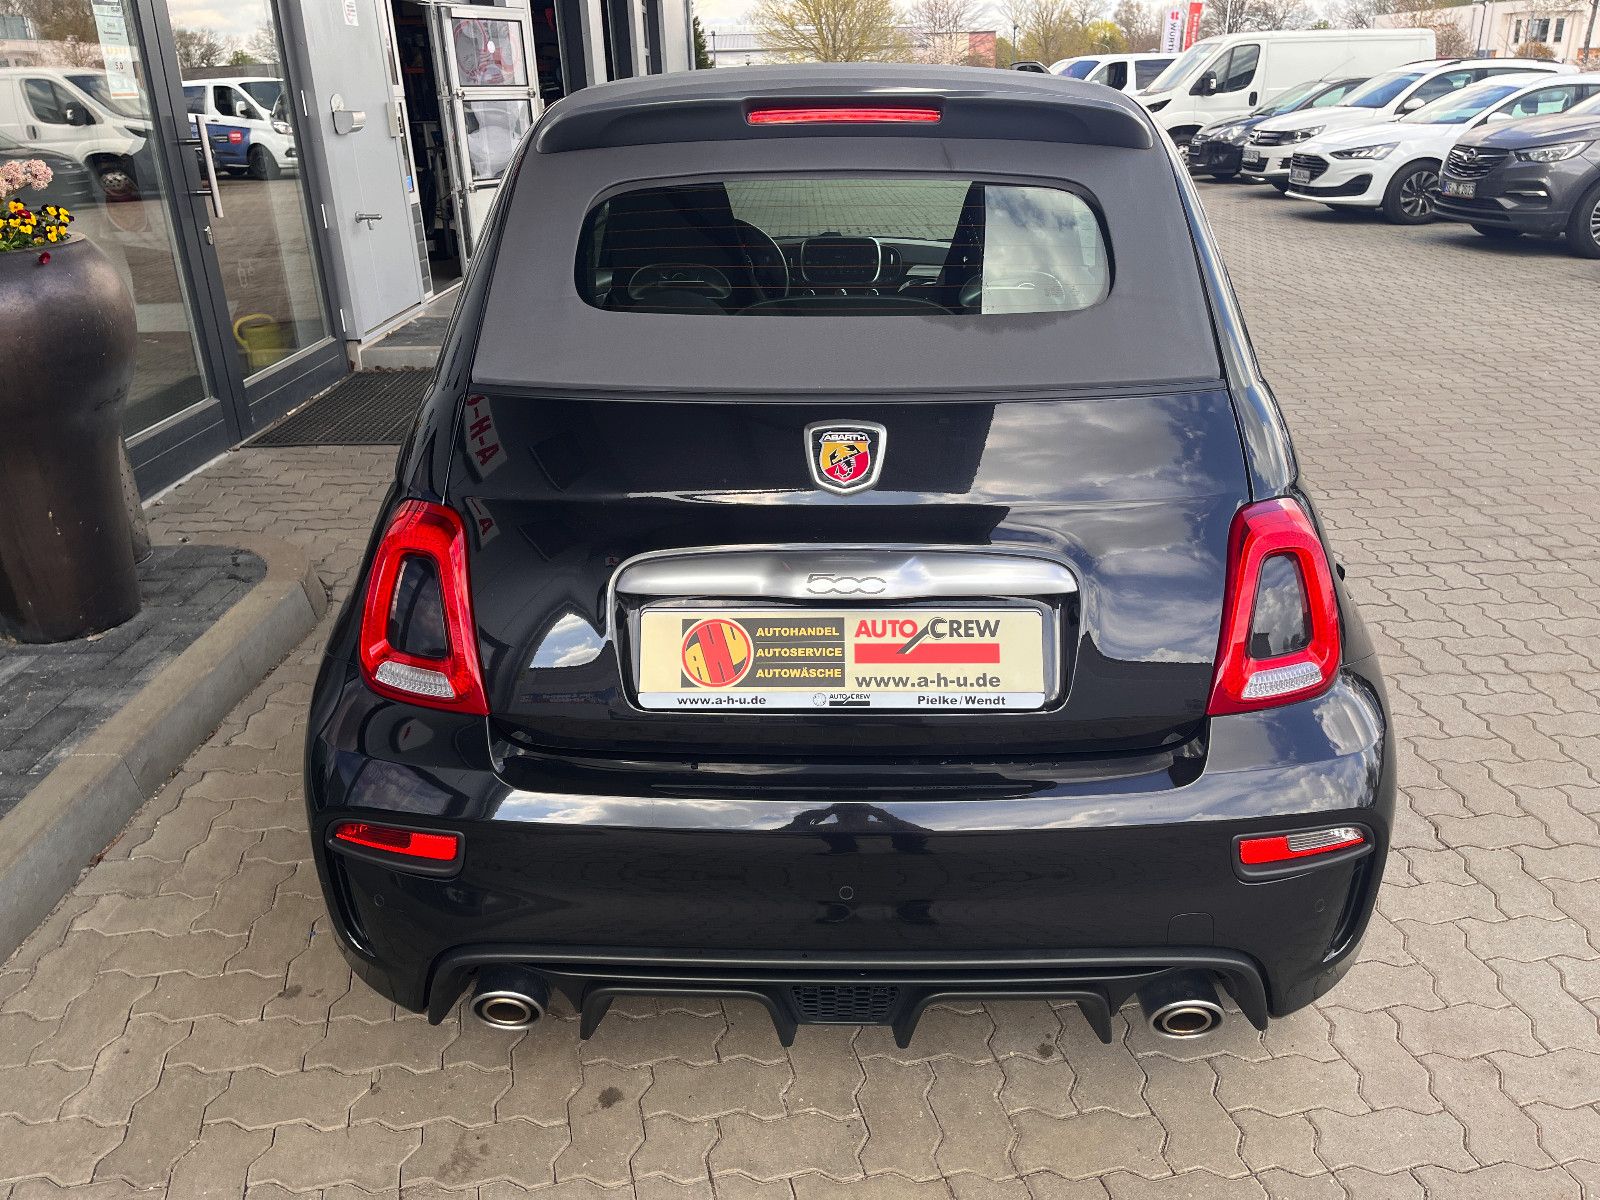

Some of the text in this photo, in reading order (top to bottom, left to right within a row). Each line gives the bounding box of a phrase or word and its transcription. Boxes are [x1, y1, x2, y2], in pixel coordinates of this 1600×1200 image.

[806, 573, 887, 595] 500
[755, 627, 840, 637] AUTOHANDEL
[854, 617, 1001, 640] AUTO CREW
[755, 647, 843, 657] AUTOSERVICE
[755, 667, 842, 678] AUTOWÄSCHE
[855, 672, 1001, 688] www.a-h-u.de
[677, 694, 766, 705] www.a-h-u.de
